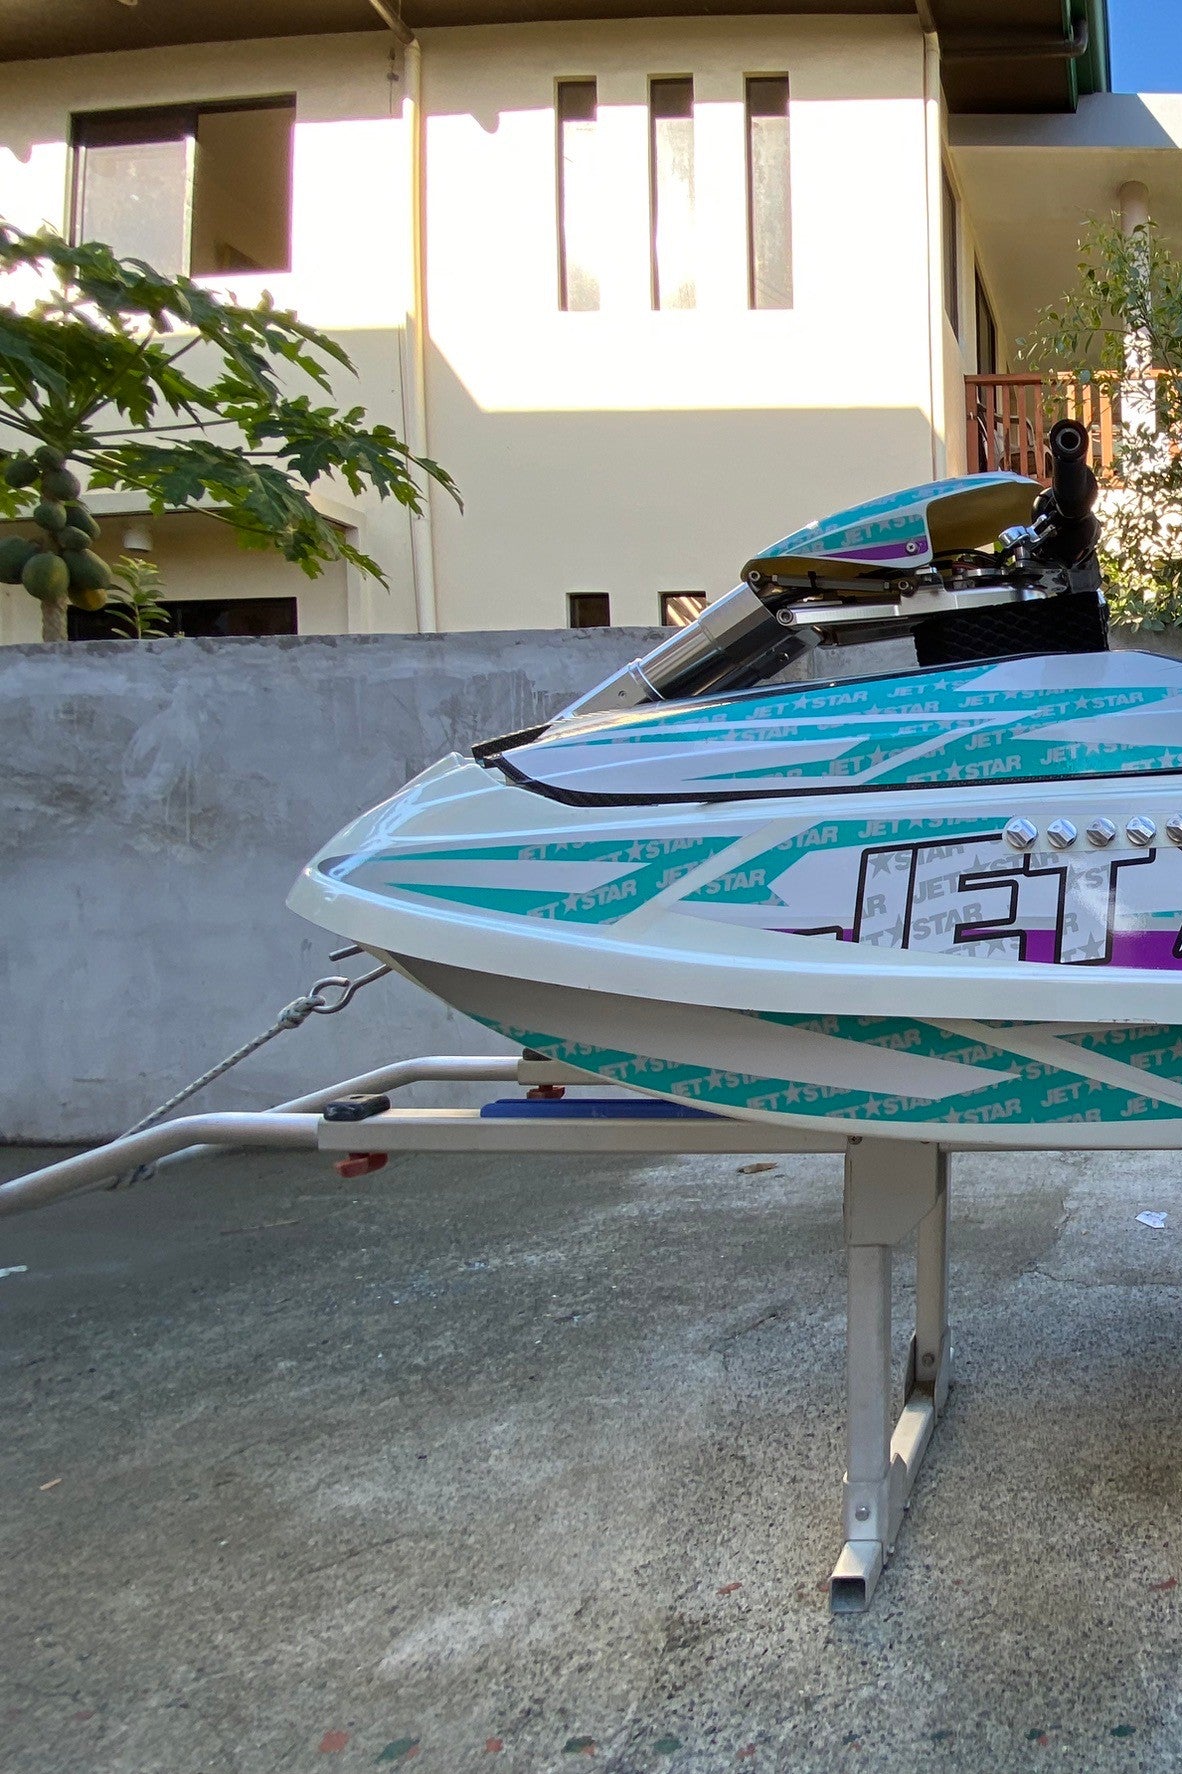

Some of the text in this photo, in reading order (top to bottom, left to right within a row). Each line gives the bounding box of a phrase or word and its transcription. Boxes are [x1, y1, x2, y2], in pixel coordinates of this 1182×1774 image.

[812, 691, 867, 709] STAR
[959, 694, 998, 708] JET
[1096, 691, 1144, 709] STAR
[966, 730, 1006, 751] JET
[1040, 742, 1079, 764] JET
